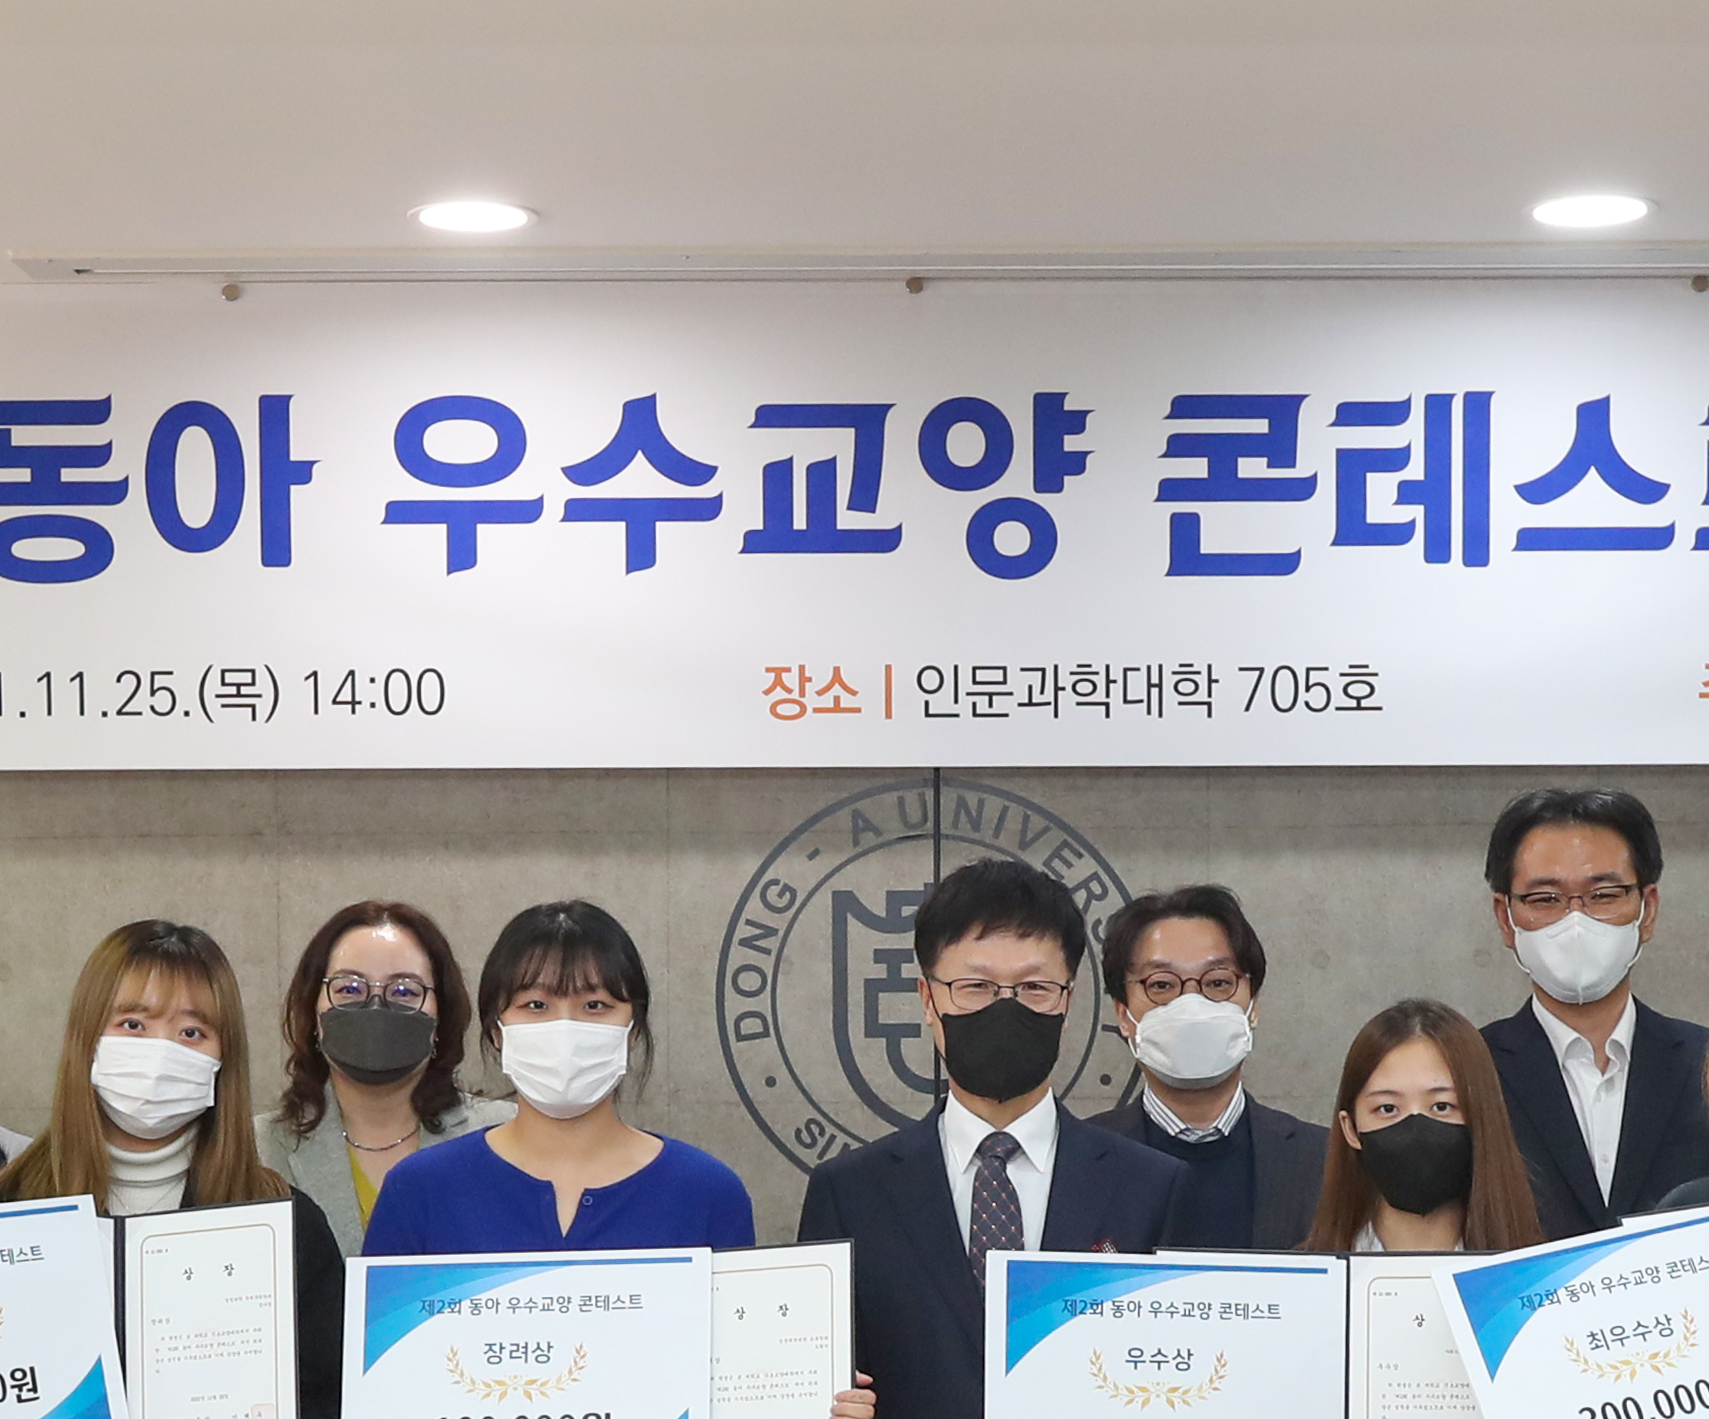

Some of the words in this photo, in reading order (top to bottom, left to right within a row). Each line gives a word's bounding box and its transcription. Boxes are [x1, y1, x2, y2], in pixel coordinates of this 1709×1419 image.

[380, 391, 1096, 581] 우수교양
[303, 667, 446, 717] 14:00
[761, 663, 863, 722] 장소
[915, 662, 1221, 720] 인문과학대학
[1237, 663, 1384, 714] 705호
[418, 1297, 463, 1317] 제2회
[467, 1297, 502, 1317] 동아
[505, 1295, 573, 1315] 우수교양
[577, 1293, 644, 1313] 콘테스트
[1517, 1288, 1562, 1312] 제2회
[1563, 1280, 1597, 1304] 동아
[1600, 1265, 1662, 1295] 우수교양
[1061, 1298, 1105, 1318] 제2회
[1109, 1299, 1143, 1319] 동아
[1147, 1300, 1213, 1321] 우수교양
[1217, 1301, 1282, 1321] 콘테스트
[482, 1340, 555, 1366] 장려상
[1585, 1313, 1675, 1354] 최우수상
[1124, 1346, 1195, 1372] 우수상
